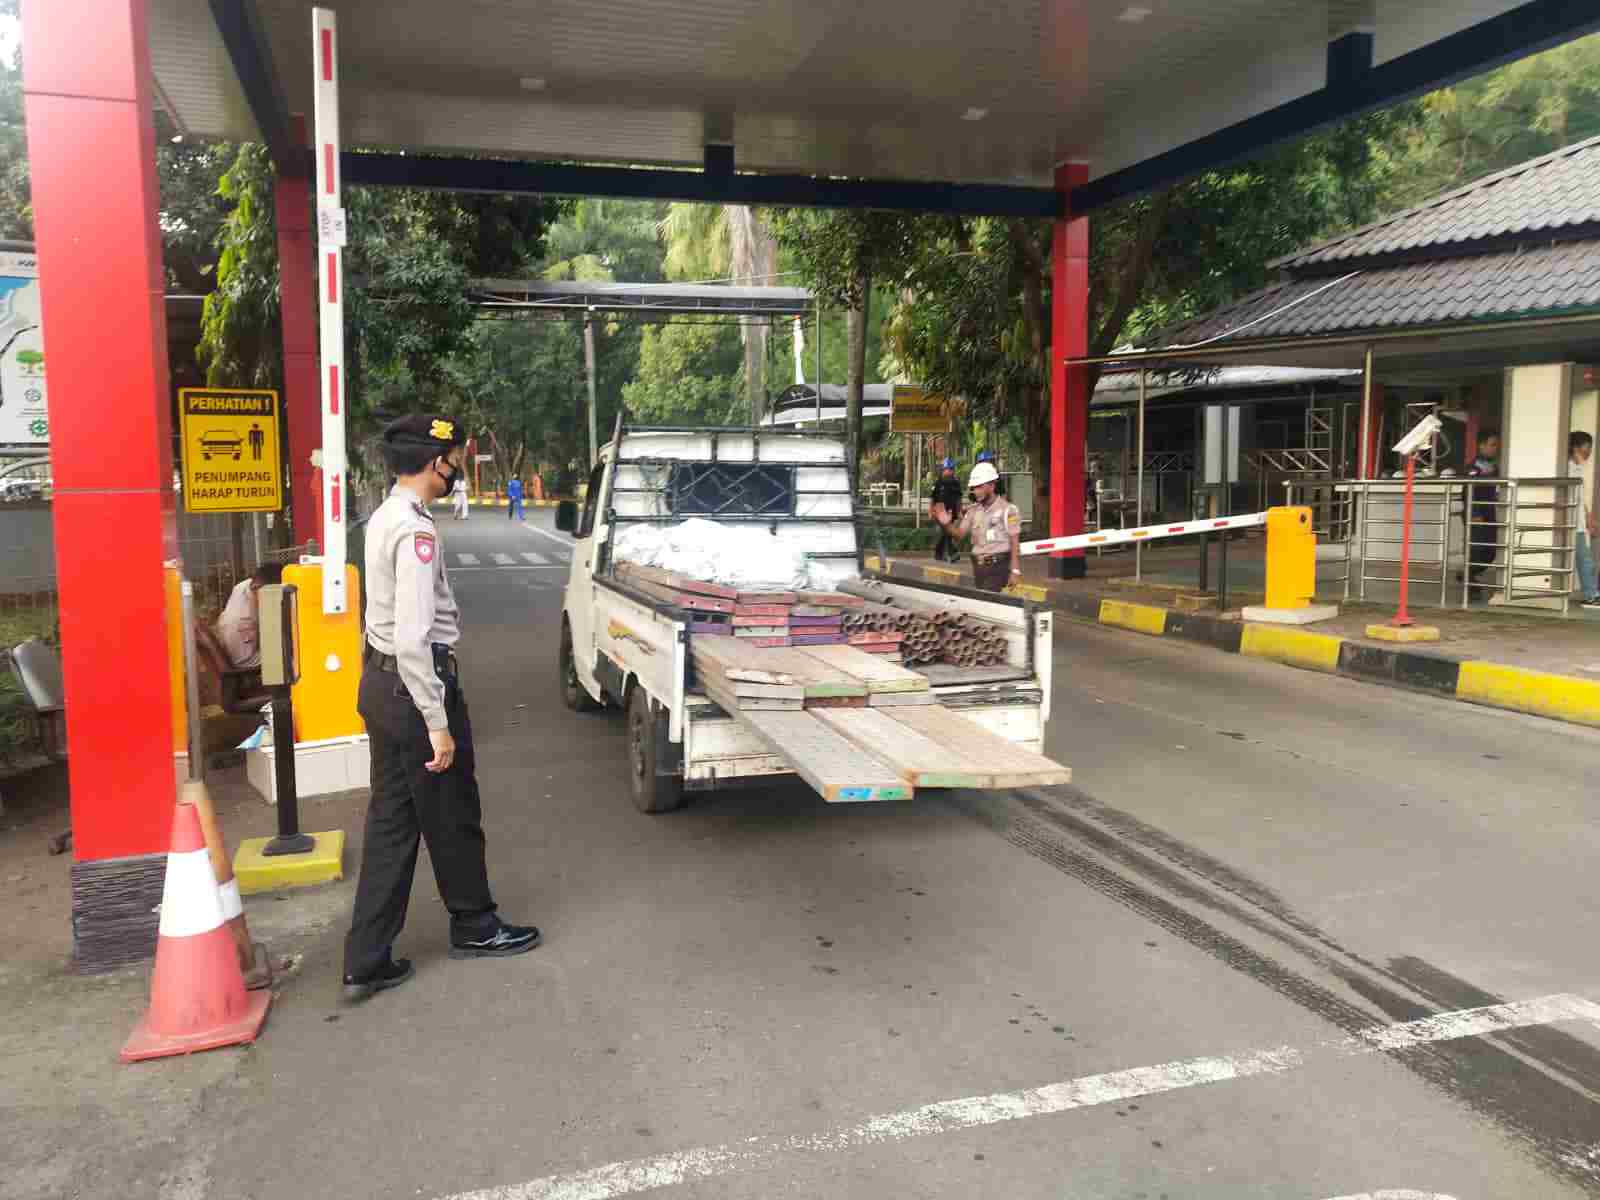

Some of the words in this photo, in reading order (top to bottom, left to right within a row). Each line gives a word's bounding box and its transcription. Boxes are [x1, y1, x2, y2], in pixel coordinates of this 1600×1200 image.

[190, 397, 261, 411] PERHATIAN
[194, 471, 271, 483] PENUMPANG
[192, 487, 232, 499] HARAP
[236, 486, 275, 498] TURUN
